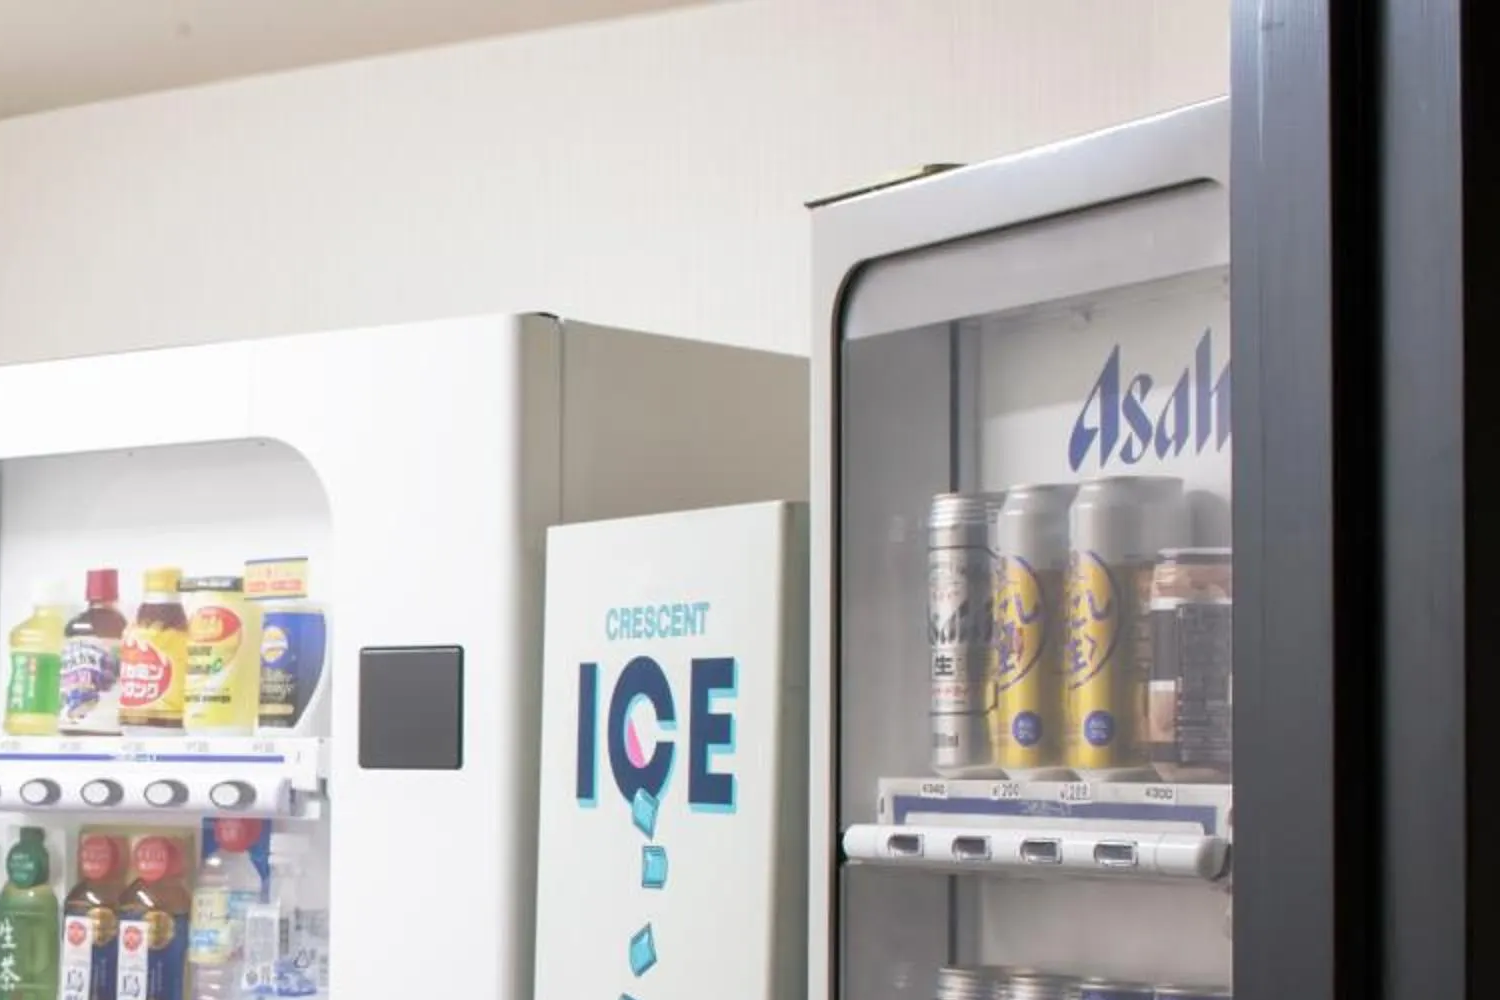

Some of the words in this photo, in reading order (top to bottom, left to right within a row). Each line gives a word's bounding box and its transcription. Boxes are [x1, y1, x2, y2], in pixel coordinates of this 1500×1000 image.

[1068, 327, 1232, 472] Asah
[605, 602, 710, 640] CRESCENT
[576, 655, 739, 814] ICE
